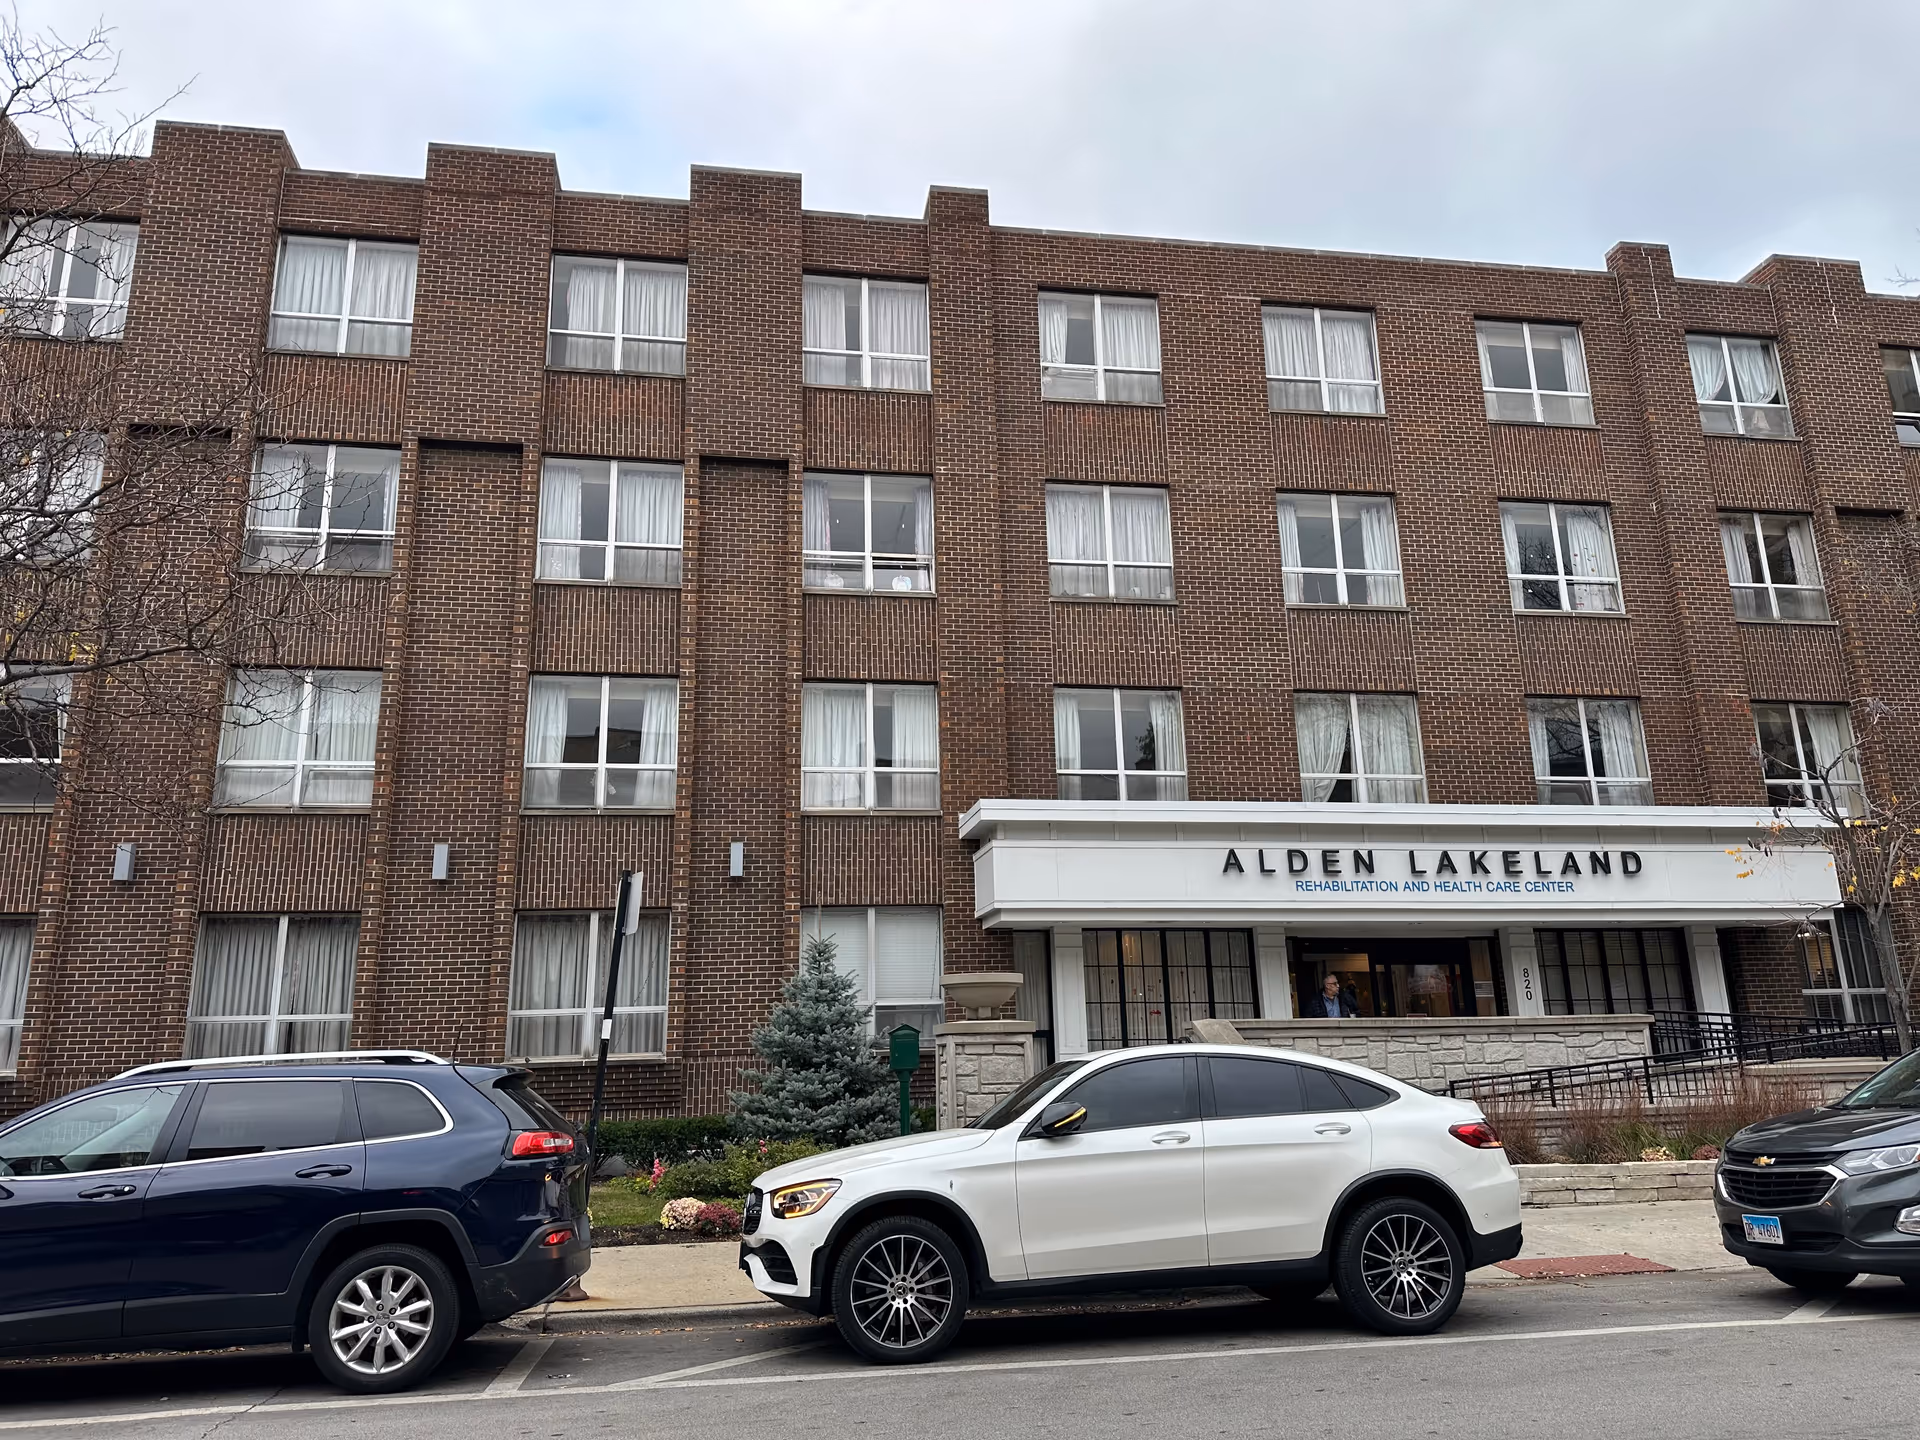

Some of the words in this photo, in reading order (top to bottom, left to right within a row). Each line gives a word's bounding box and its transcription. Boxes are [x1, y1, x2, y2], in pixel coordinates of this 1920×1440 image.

[1222, 848, 1375, 874] ALDEN
[1408, 850, 1643, 875] LAKELAND
[1295, 880, 1398, 892] REHABILITATION
[1402, 880, 1430, 892] AND
[1433, 881, 1483, 893] HEALTH
[1486, 881, 1521, 893] CARE
[1524, 881, 1575, 893] CENTER
[1523, 967, 1533, 1000] 820
